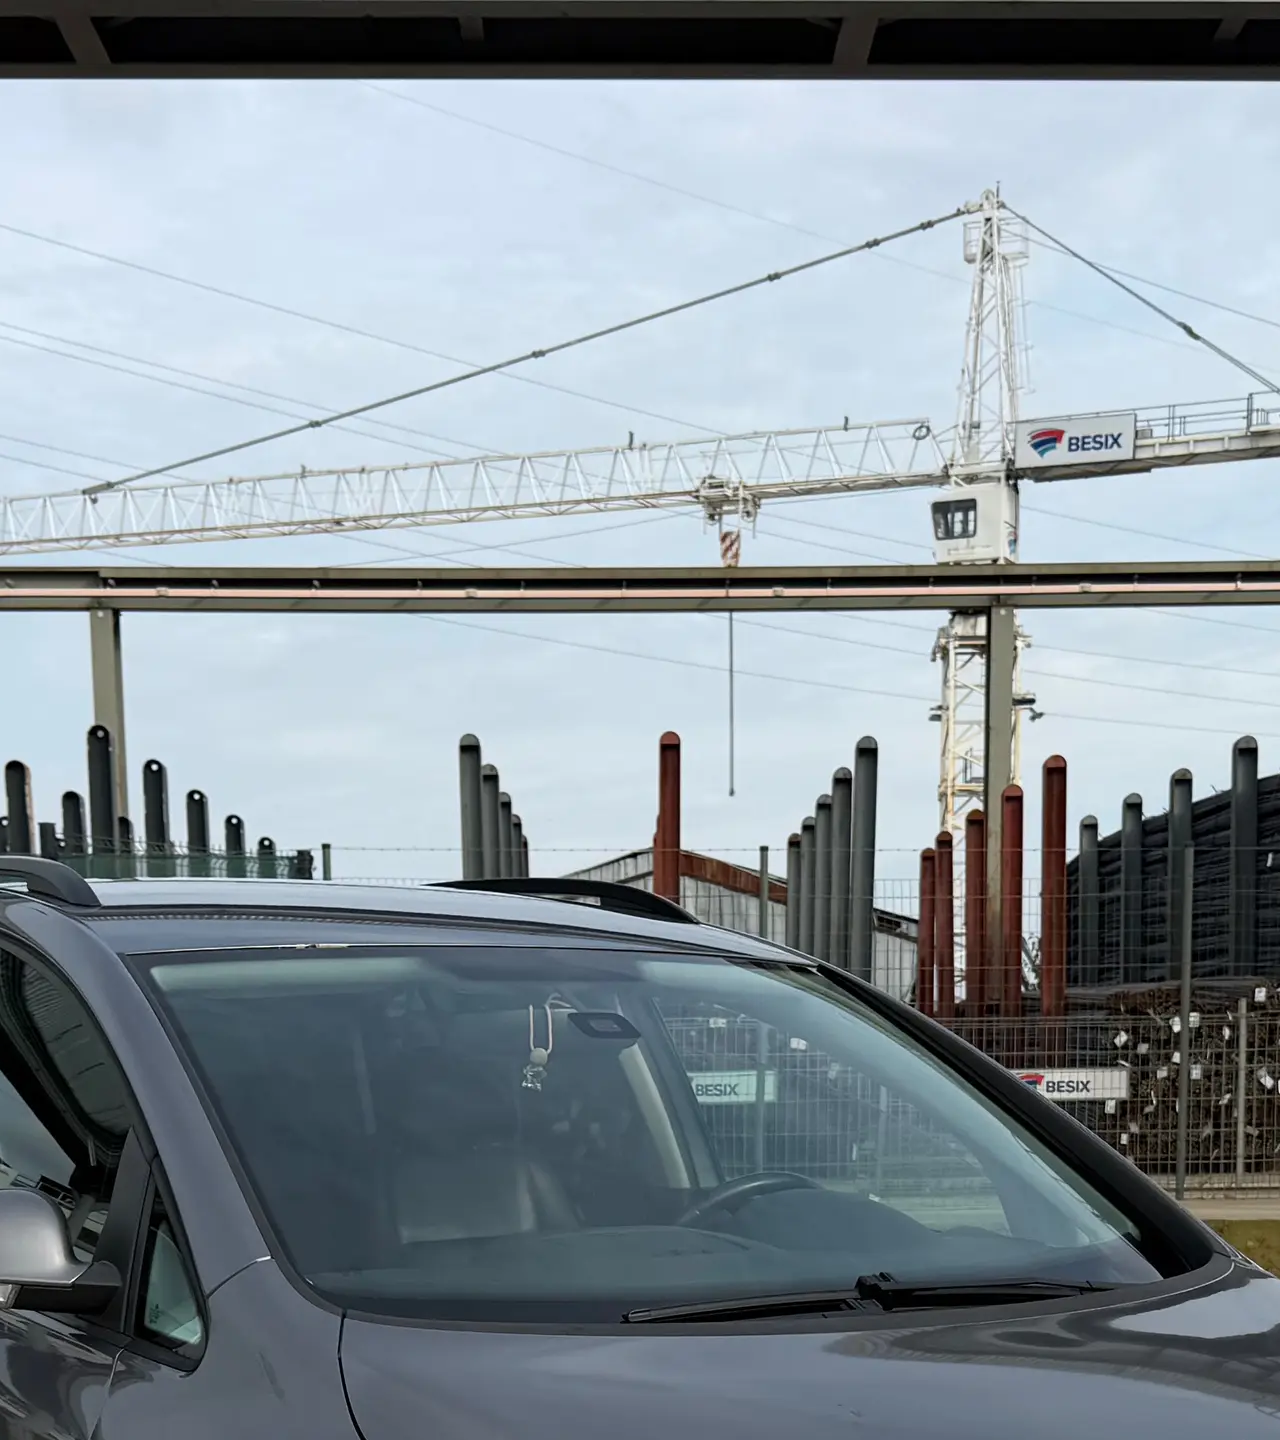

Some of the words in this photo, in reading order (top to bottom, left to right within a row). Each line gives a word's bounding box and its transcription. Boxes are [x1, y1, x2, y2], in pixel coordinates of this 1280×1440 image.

[1067, 432, 1123, 452] BESIX
[695, 1083, 740, 1097] BESIX
[1045, 1080, 1091, 1093] BESIX
